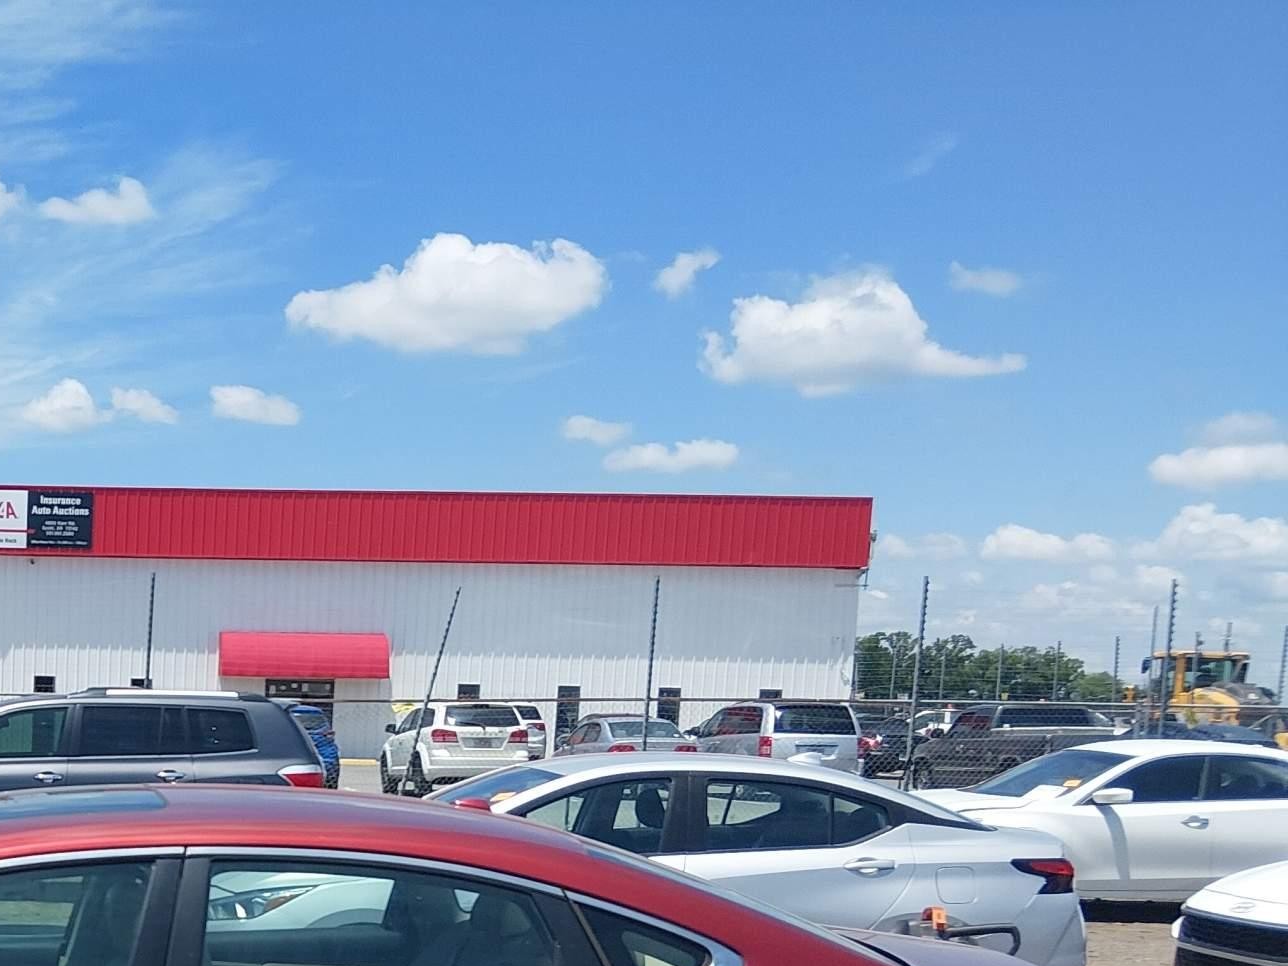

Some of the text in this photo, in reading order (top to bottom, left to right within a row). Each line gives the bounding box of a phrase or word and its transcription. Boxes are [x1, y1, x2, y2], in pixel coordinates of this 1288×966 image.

[40, 495, 82, 505] Insurance
[31, 505, 90, 516] Auto Auctions
